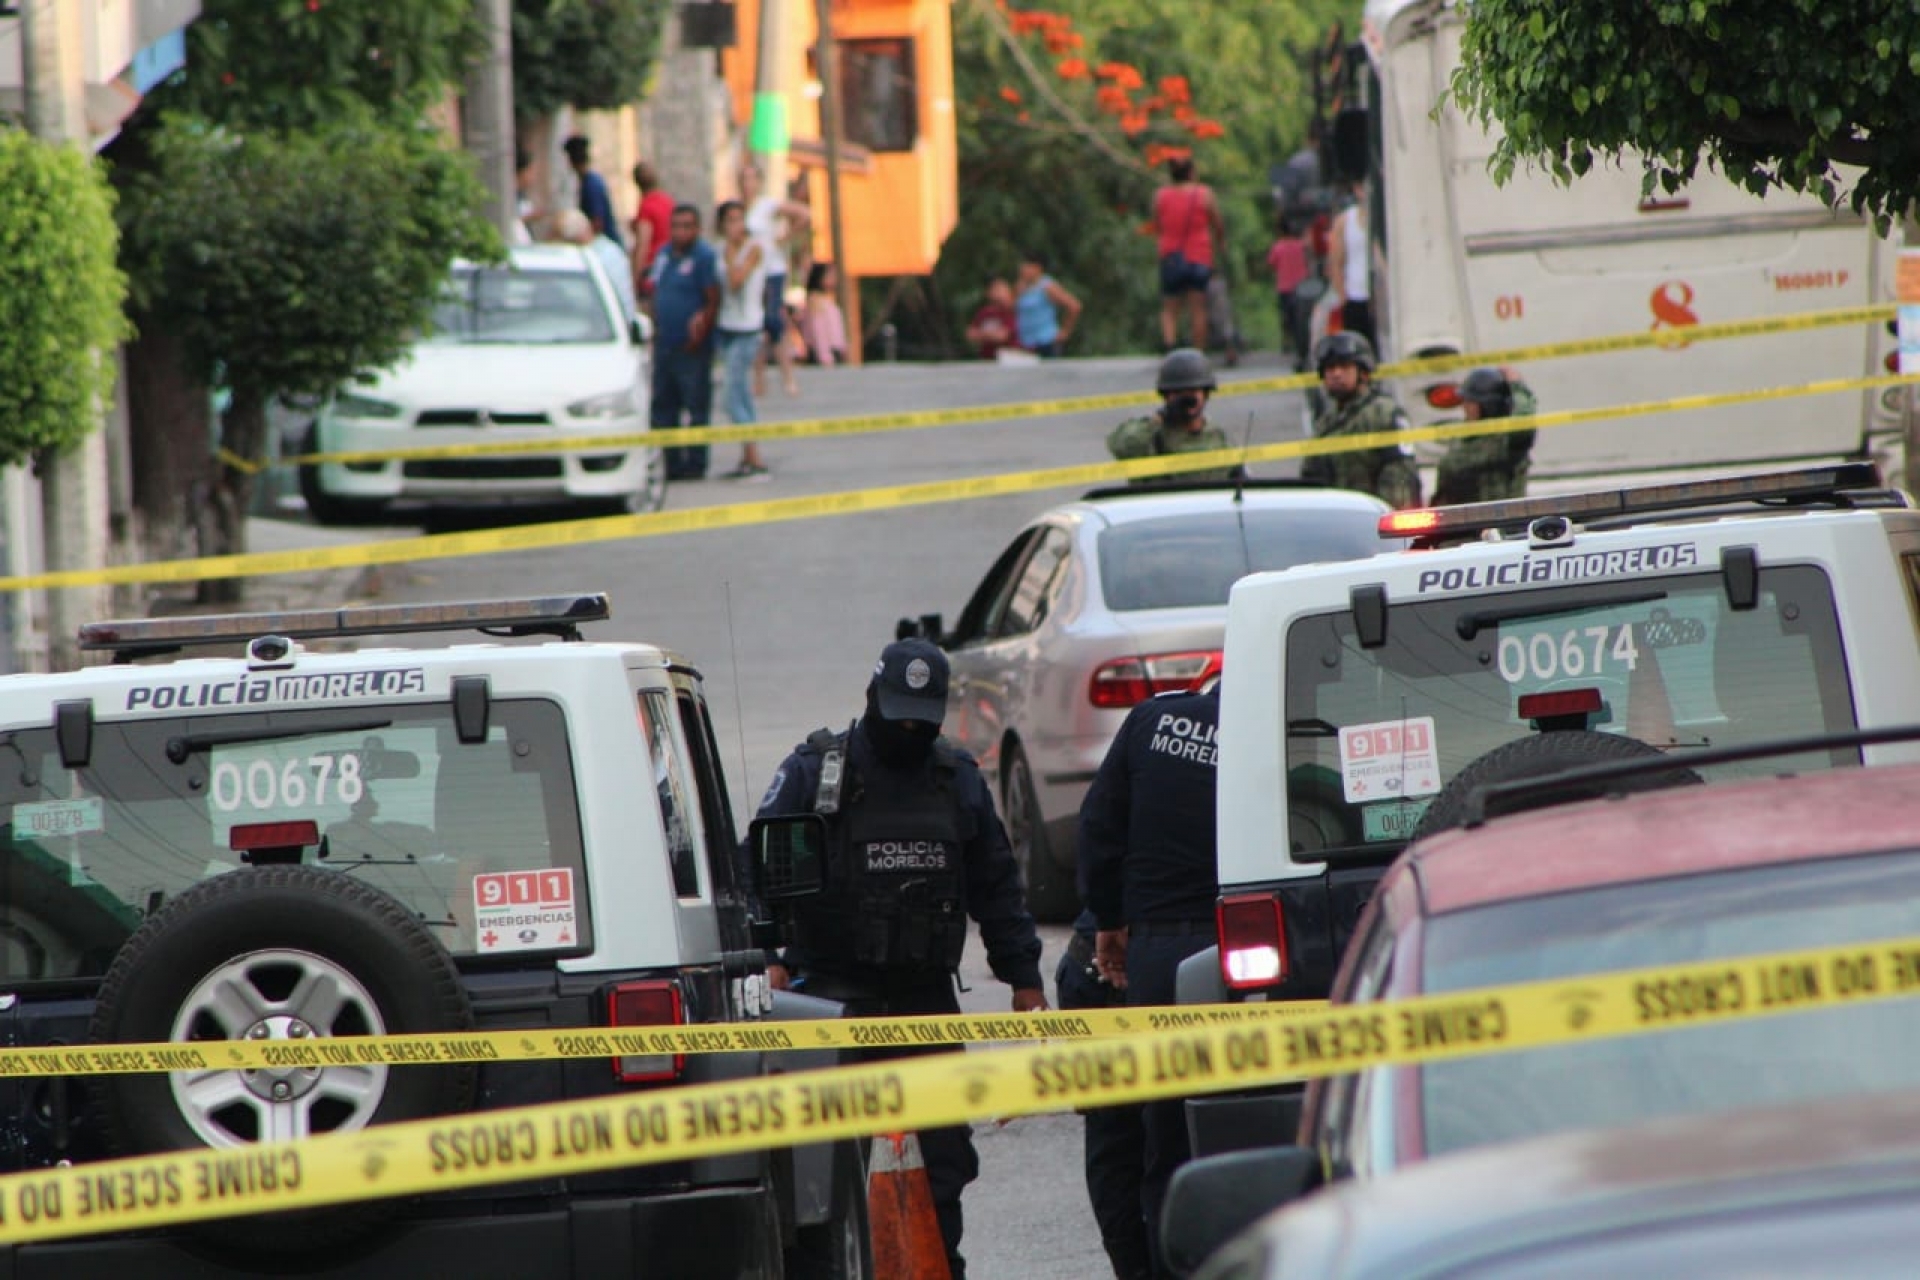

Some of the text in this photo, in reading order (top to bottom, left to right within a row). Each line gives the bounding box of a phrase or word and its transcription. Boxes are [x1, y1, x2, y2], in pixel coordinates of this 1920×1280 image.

[1494, 295, 1523, 320] 01
[1556, 542, 1697, 579] MORELOS
[1499, 622, 1638, 683] 00674
[276, 668, 424, 700] MORELOS
[1157, 713, 1219, 744] POLI
[1353, 728, 1421, 756] 911
[1149, 733, 1218, 767] MOREL
[213, 753, 363, 812] 00678
[868, 854, 946, 870] MORELOS
[483, 875, 560, 903] 911
[479, 912, 574, 928] EMERGENCIAS
[1152, 1036, 1213, 1083] NOT
[1226, 1028, 1270, 1072] DO
[1031, 1046, 1139, 1098] CROSS
[429, 1073, 904, 1172] CRIME SCENE DO NOT CROSS
[77, 1164, 181, 1215] SCENE
[196, 1149, 301, 1200] CRIME
[19, 1180, 61, 1222] DO
